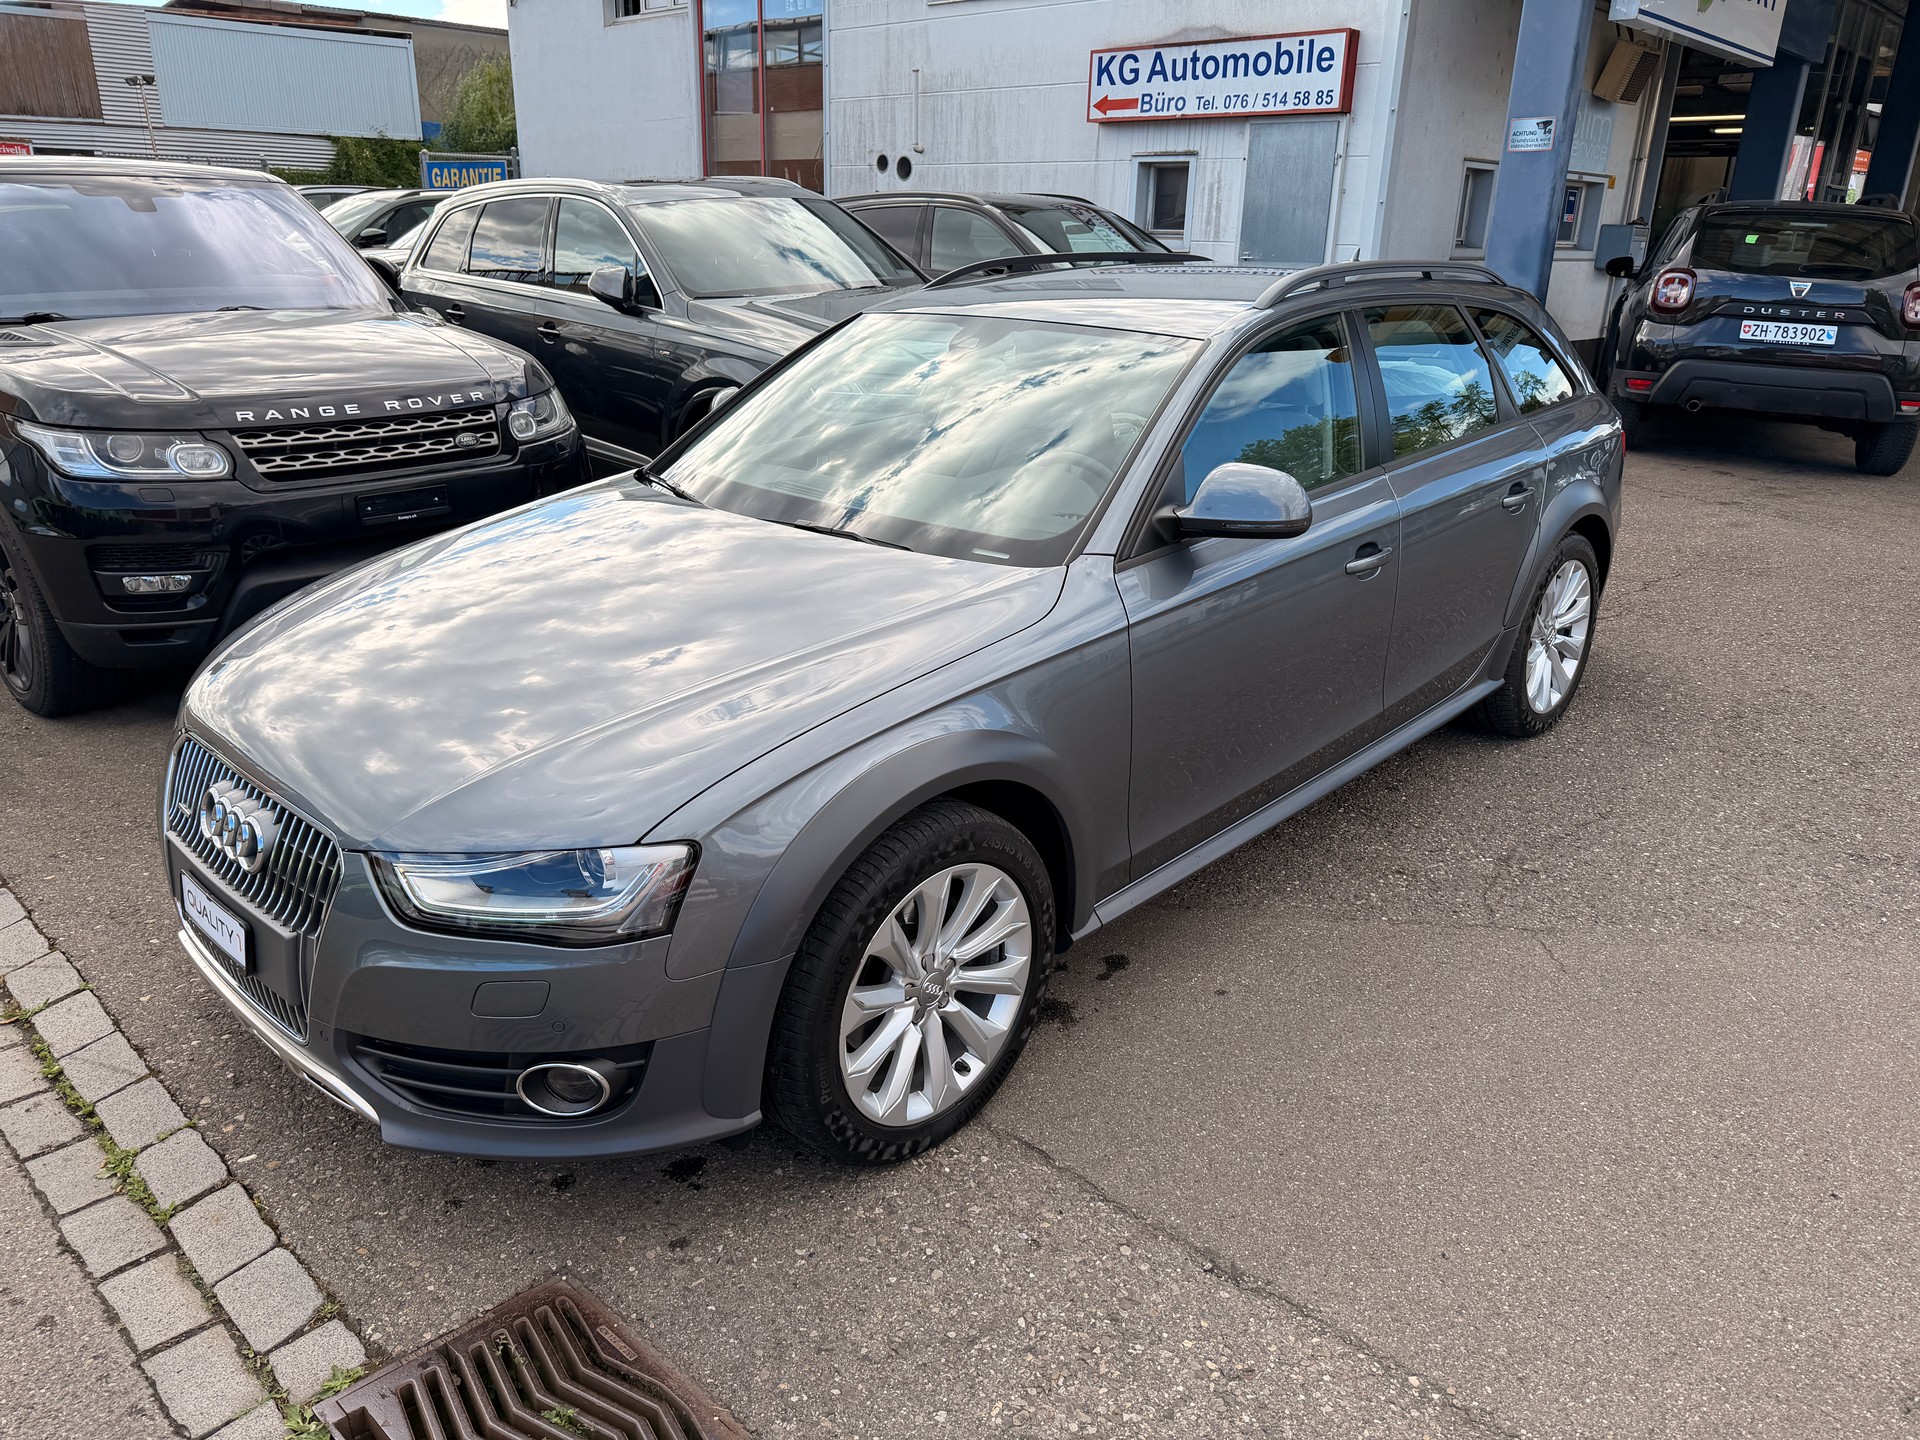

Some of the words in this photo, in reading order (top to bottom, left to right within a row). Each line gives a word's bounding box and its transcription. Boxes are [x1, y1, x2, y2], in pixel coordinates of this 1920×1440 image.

[1096, 53, 1140, 86] KG
[1146, 38, 1335, 84] Automobile
[1140, 92, 1186, 114] Büro
[1195, 95, 1218, 111] Tel.
[1223, 93, 1248, 109] 076
[1261, 91, 1288, 107] 514
[1292, 90, 1310, 106] 58
[1315, 89, 1334, 105] 85
[0, 145, 27, 156] ivella
[1571, 141, 1607, 160] ervice
[431, 167, 502, 187] GARANTIE
[1743, 306, 1846, 319] DUSTER
[235, 403, 361, 422] RANGE
[383, 391, 485, 411] ROVER
